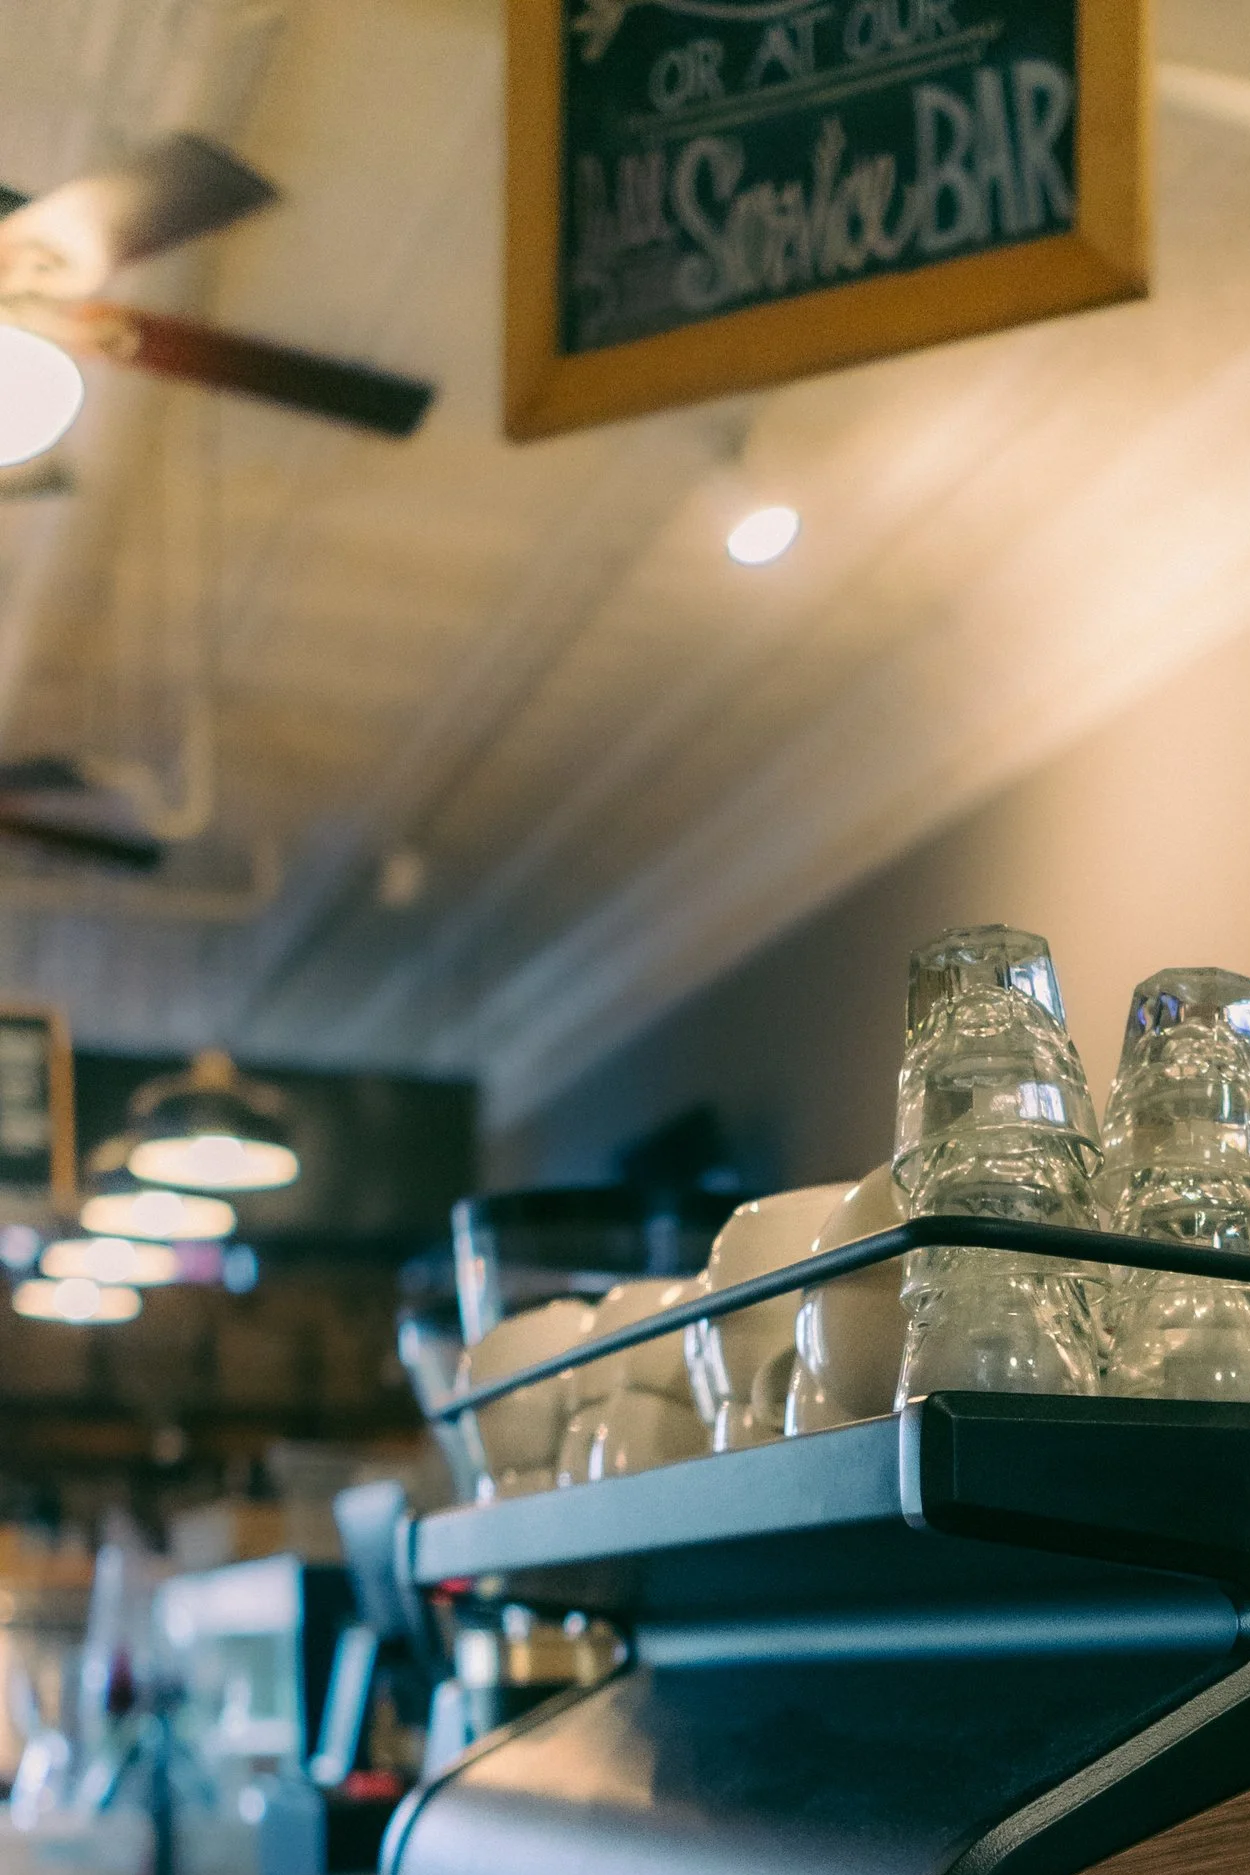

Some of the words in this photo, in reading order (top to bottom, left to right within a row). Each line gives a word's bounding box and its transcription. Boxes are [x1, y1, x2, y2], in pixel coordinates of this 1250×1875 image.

[649, 39, 727, 114] OR
[752, 11, 828, 87] AT
[843, 0, 962, 60] OUR
[911, 58, 1076, 254] BAR
